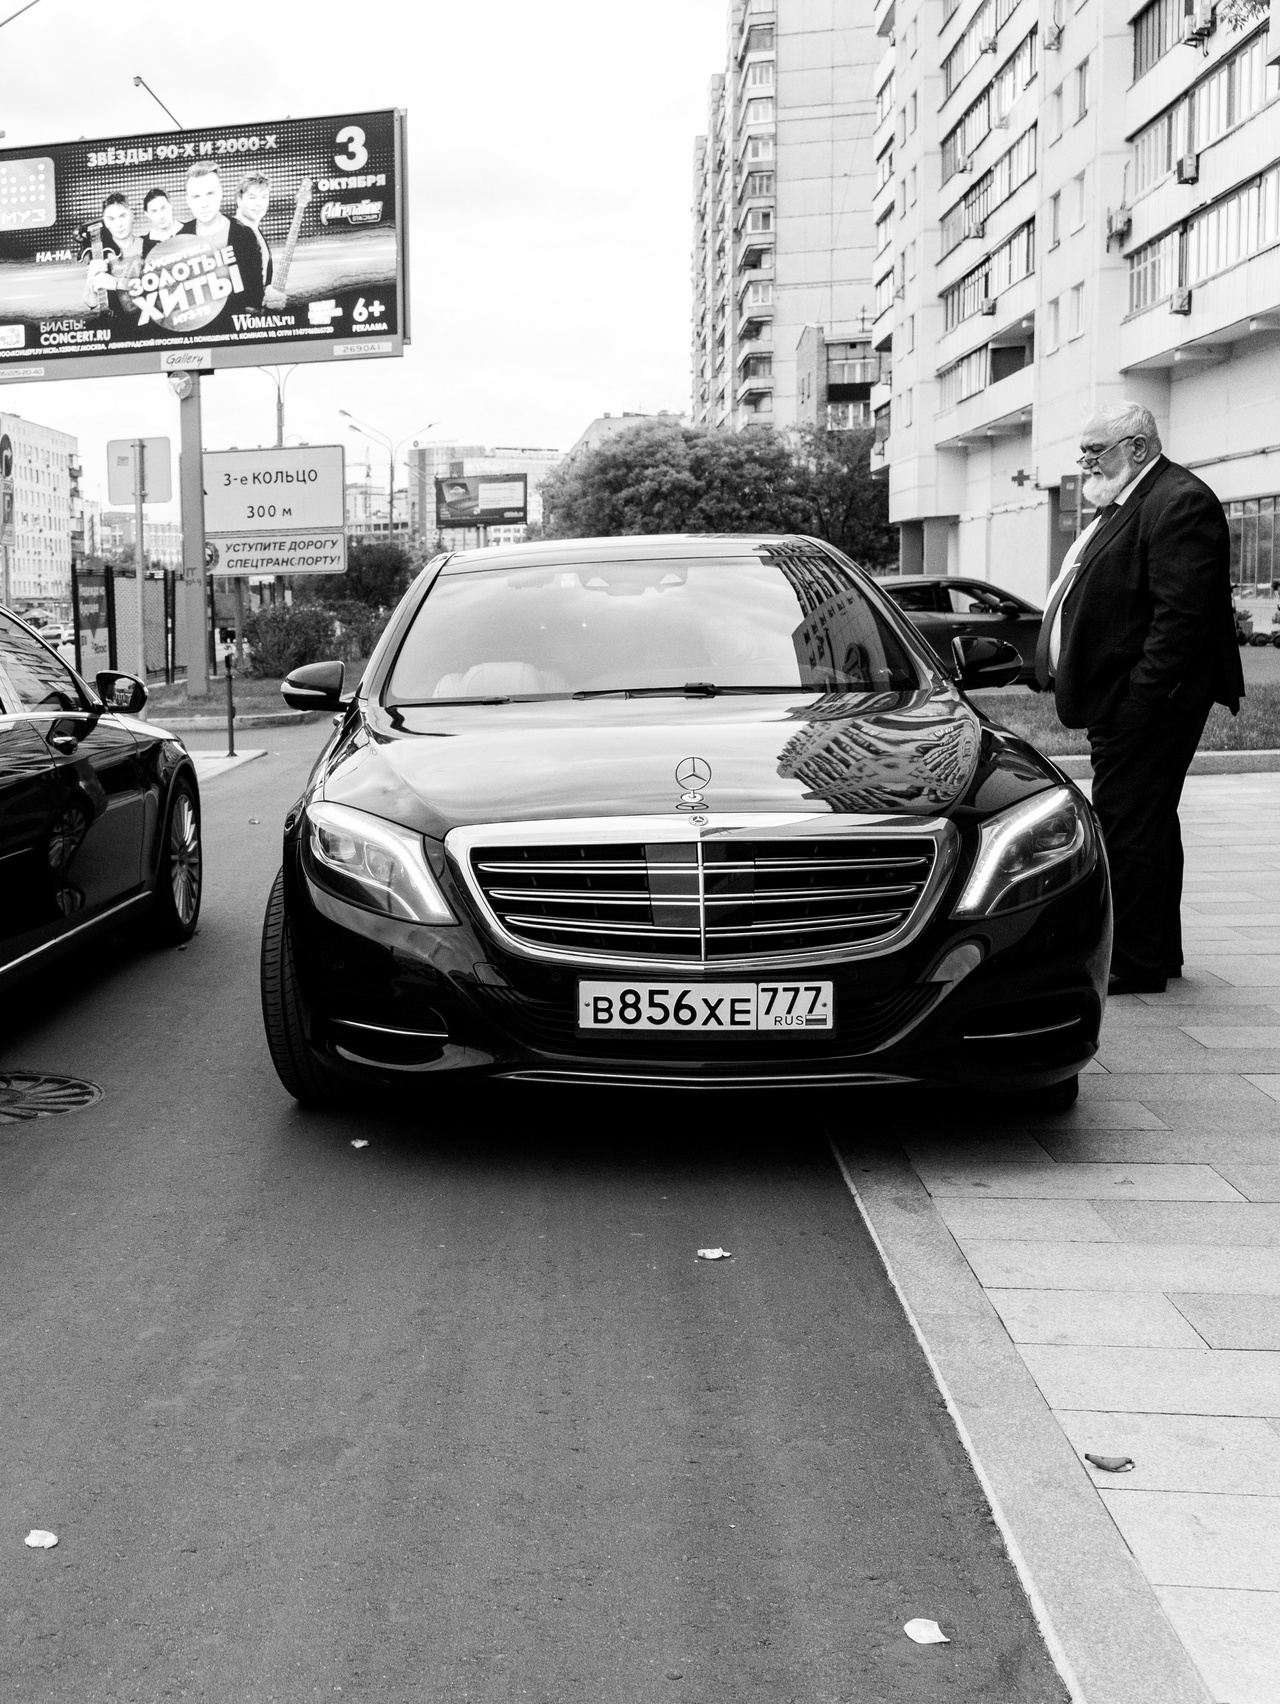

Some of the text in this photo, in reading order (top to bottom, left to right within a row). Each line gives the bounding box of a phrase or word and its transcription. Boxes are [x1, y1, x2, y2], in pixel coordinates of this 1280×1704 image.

[87, 147, 153, 167] ЗВЁЗДЫ
[200, 141, 212, 155] И
[334, 126, 368, 171] 3
[317, 174, 386, 191] ОКТЯБРЯ
[1, 208, 47, 224] МУЗ
[320, 199, 383, 225] Adrenaline
[36, 249, 72, 262] НА-НА
[128, 245, 237, 297] ЗОЛОТЫЕ
[131, 264, 245, 327] ХИТЫ
[352, 297, 386, 322] 6+
[40, 320, 87, 333] БИЛЕТЫ:
[352, 322, 388, 333] РЕКЛАМА
[40, 329, 112, 346] CONCERT.RU
[166, 354, 204, 367] Gallery
[223, 469, 318, 487] 3-е КОЛЬЦО
[247, 505, 292, 519] 300 м
[225, 539, 339, 553] УСТУПИТЕ ДОРОГУ
[227, 555, 341, 569] СПЕЦТРАНСПОРТУ!
[760, 986, 822, 1015] 777
[774, 1015, 804, 1026] RUS
